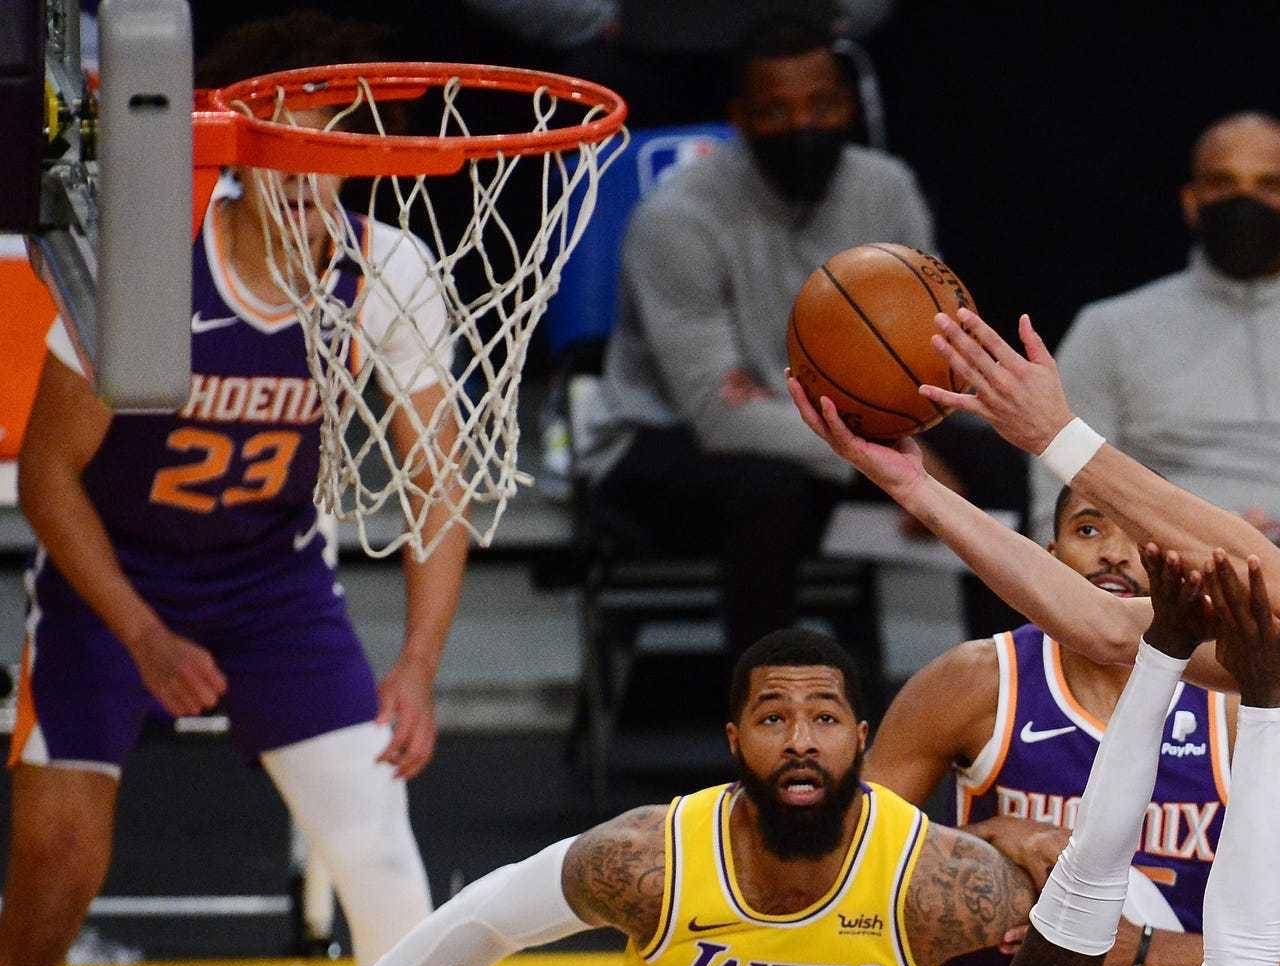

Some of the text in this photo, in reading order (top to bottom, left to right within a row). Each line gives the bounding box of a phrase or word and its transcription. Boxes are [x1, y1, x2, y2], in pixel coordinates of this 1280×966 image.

[151, 426, 302, 514] 23
[1161, 742, 1206, 758] PayPal
[838, 913, 883, 930] wish
